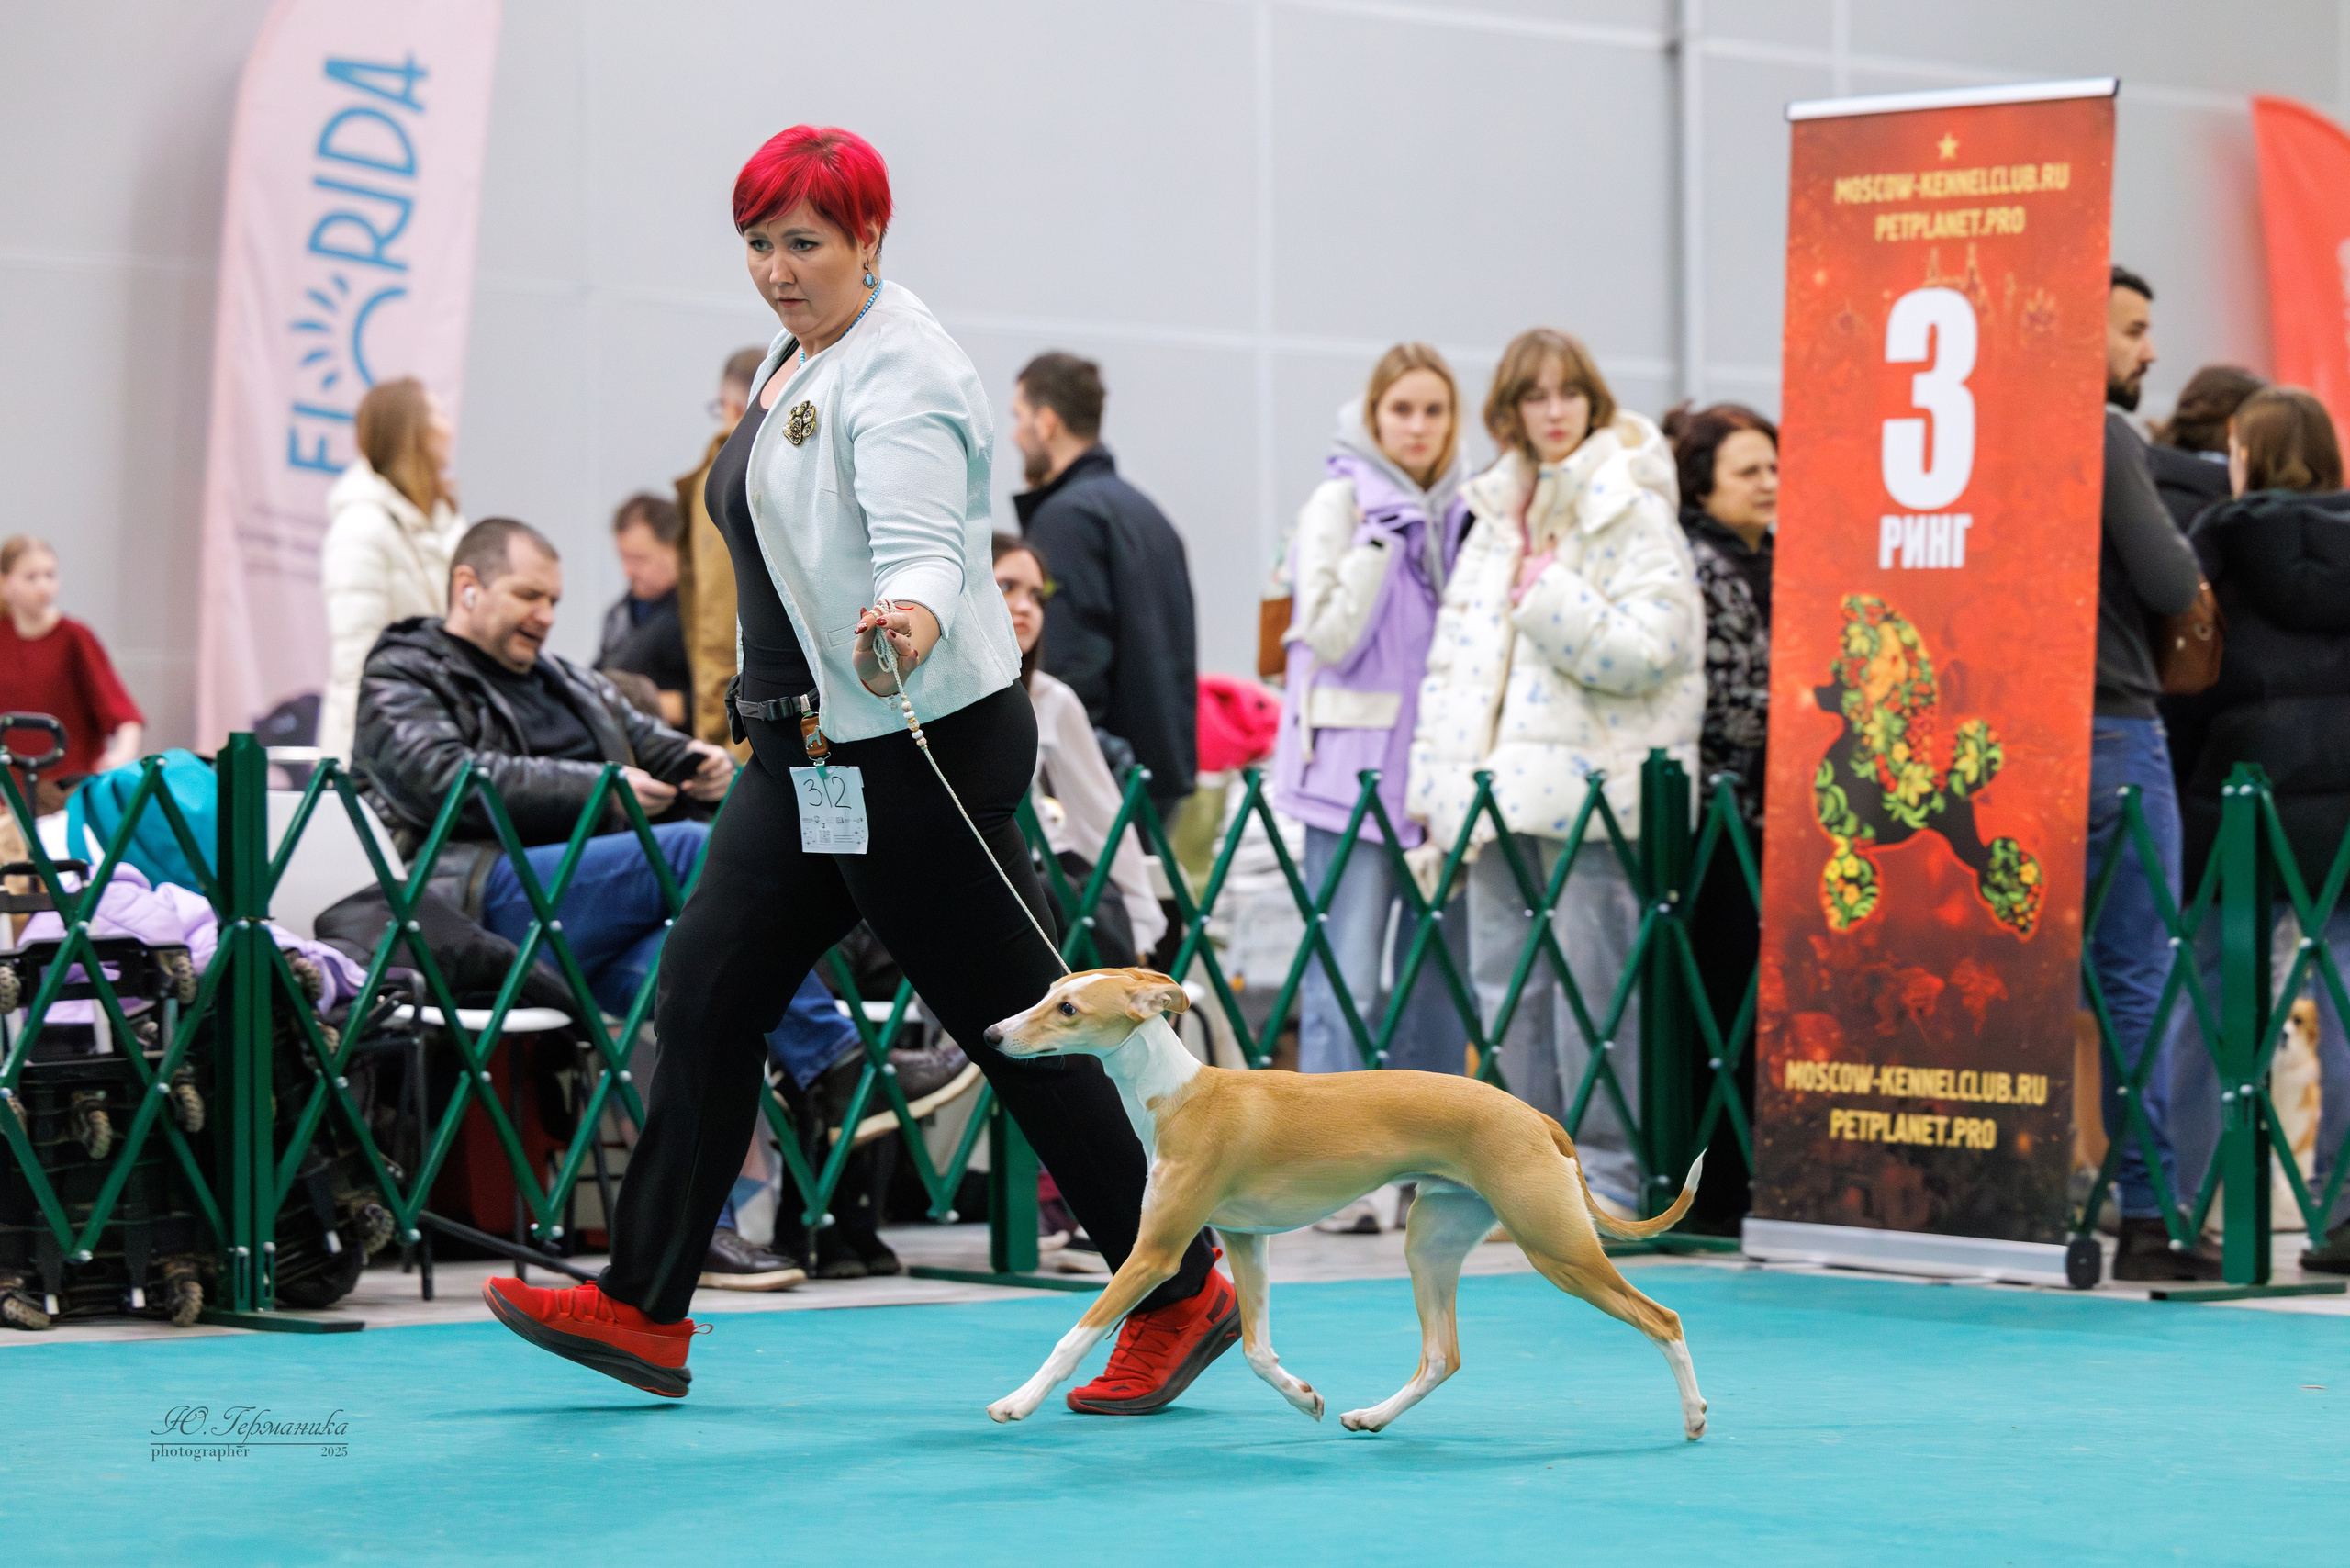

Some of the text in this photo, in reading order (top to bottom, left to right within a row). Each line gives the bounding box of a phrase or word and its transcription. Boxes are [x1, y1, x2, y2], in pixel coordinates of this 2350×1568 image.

[1834, 162, 2069, 204] MOSCOW-KENNELCLUB.RU
[1875, 207, 2026, 241] PETPLANET.PRO
[1881, 286, 1977, 510] 3
[1879, 512, 1973, 570] РИНГ
[803, 776, 852, 810] 312
[1785, 1059, 2048, 1106] MOSCOW-KENNELCLUB.RU
[1829, 1108, 1997, 1150] PETPLANET.PRO
